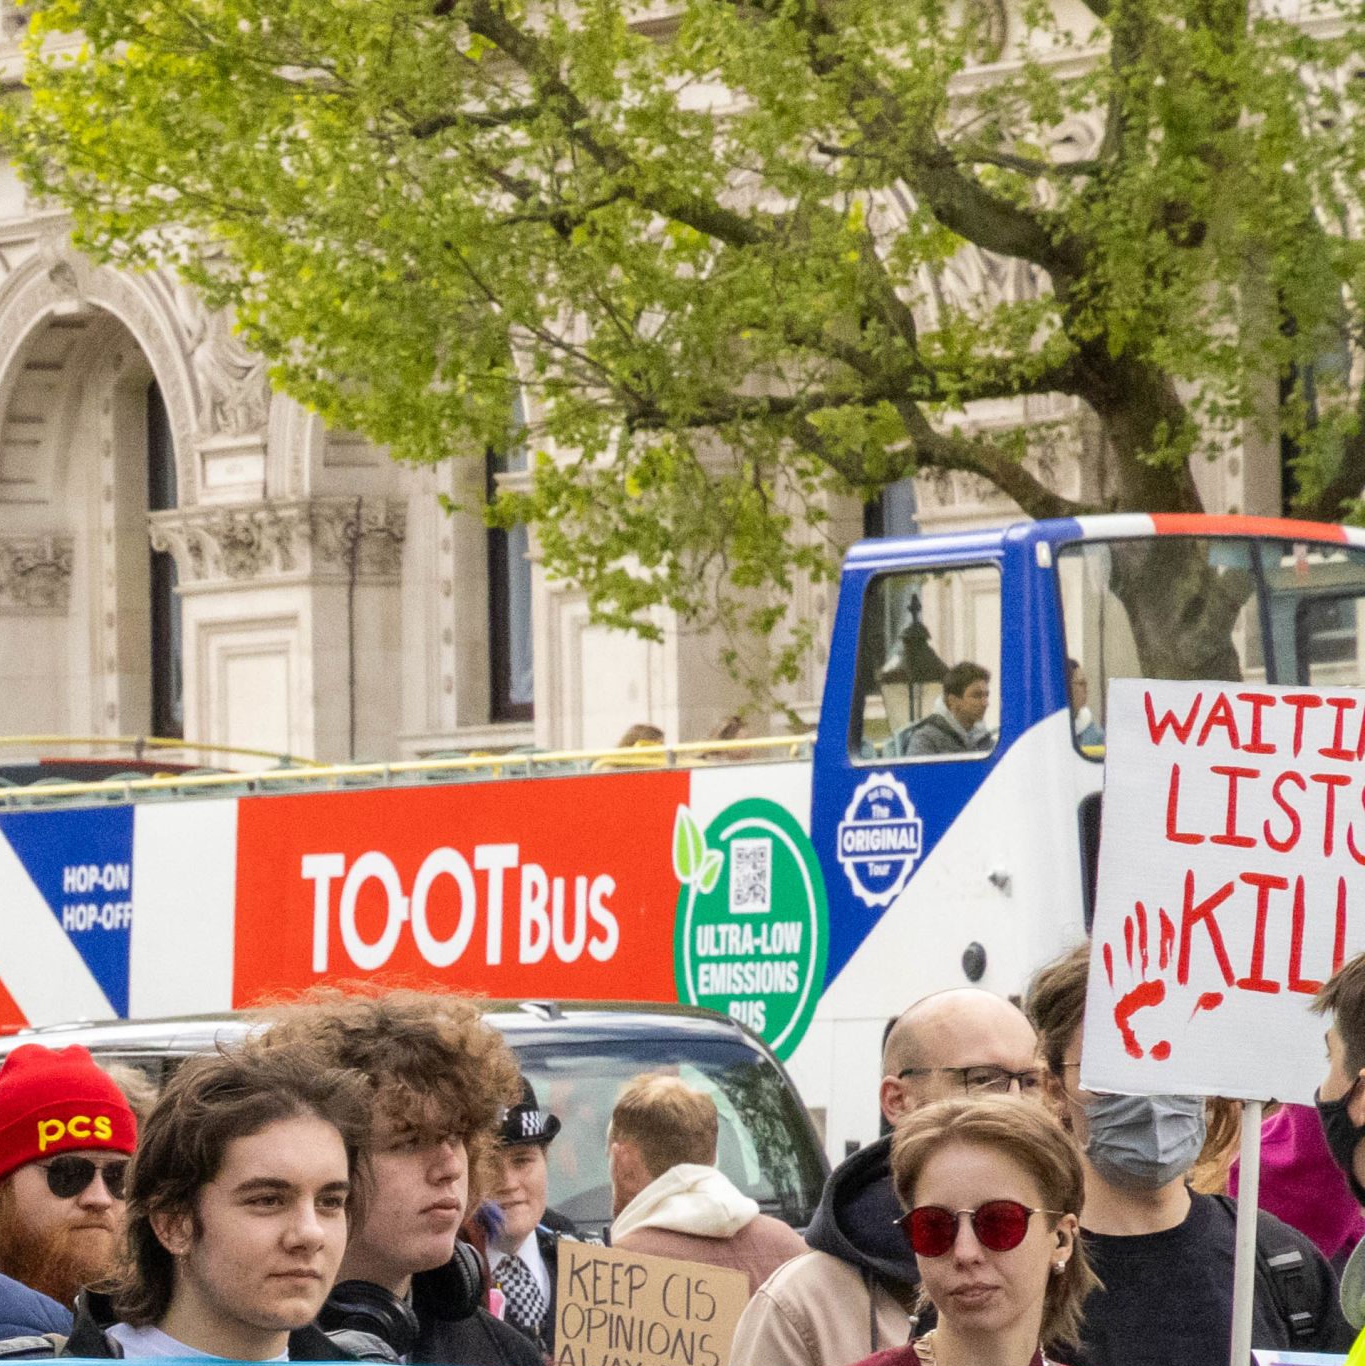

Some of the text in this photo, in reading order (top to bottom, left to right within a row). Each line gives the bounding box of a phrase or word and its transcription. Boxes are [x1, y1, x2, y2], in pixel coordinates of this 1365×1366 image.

[1144, 691, 1365, 761] WAITI
[843, 826, 917, 852] ORIGINAL
[63, 863, 129, 893] HOP-ON
[63, 902, 133, 931] HOP-OFF
[696, 922, 802, 957] ULTRA-LOW
[698, 961, 799, 995] EMISSIONS
[37, 1115, 112, 1151] pcs
[568, 1253, 717, 1322] KEEP CIS
